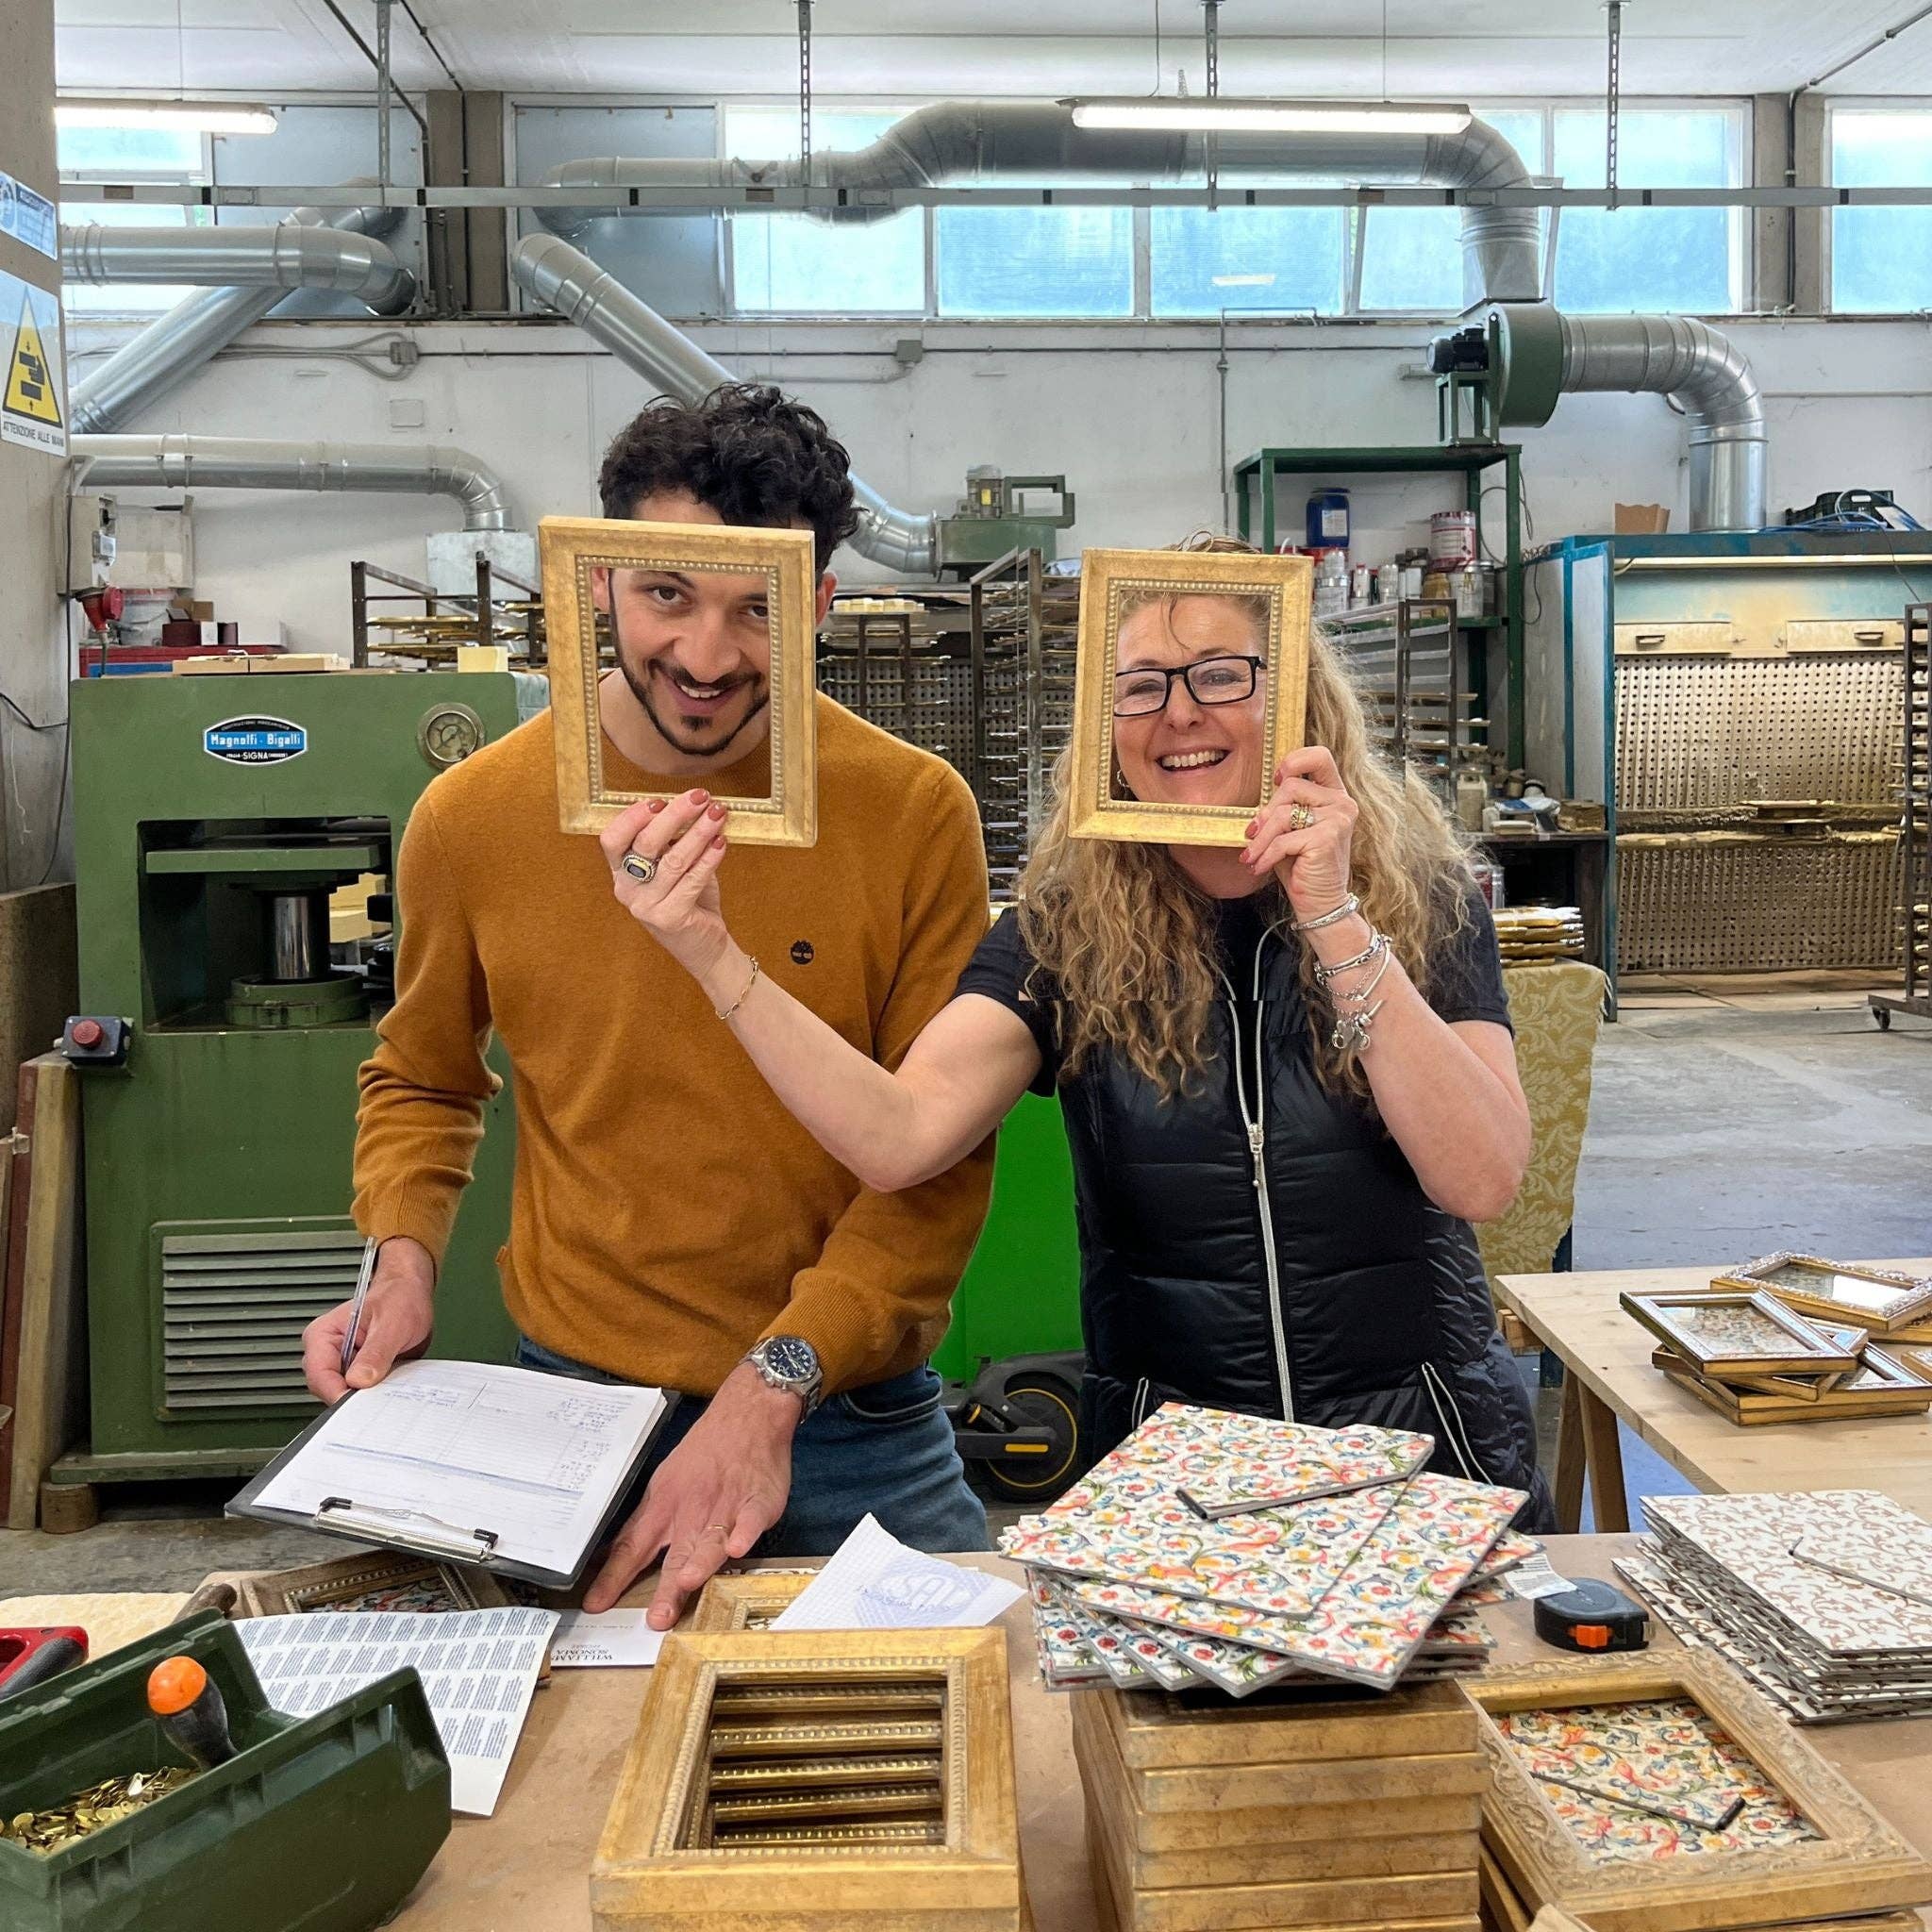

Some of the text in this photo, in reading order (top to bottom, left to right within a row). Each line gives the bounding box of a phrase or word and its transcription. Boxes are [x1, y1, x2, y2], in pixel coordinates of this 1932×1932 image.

[3, 421, 36, 440] ATTENZIONE
[37, 430, 50, 443] ALLE
[210, 734, 258, 747] Magnolfi
[267, 734, 301, 747] Bigalli
[242, 751, 269, 760] SIGNA
